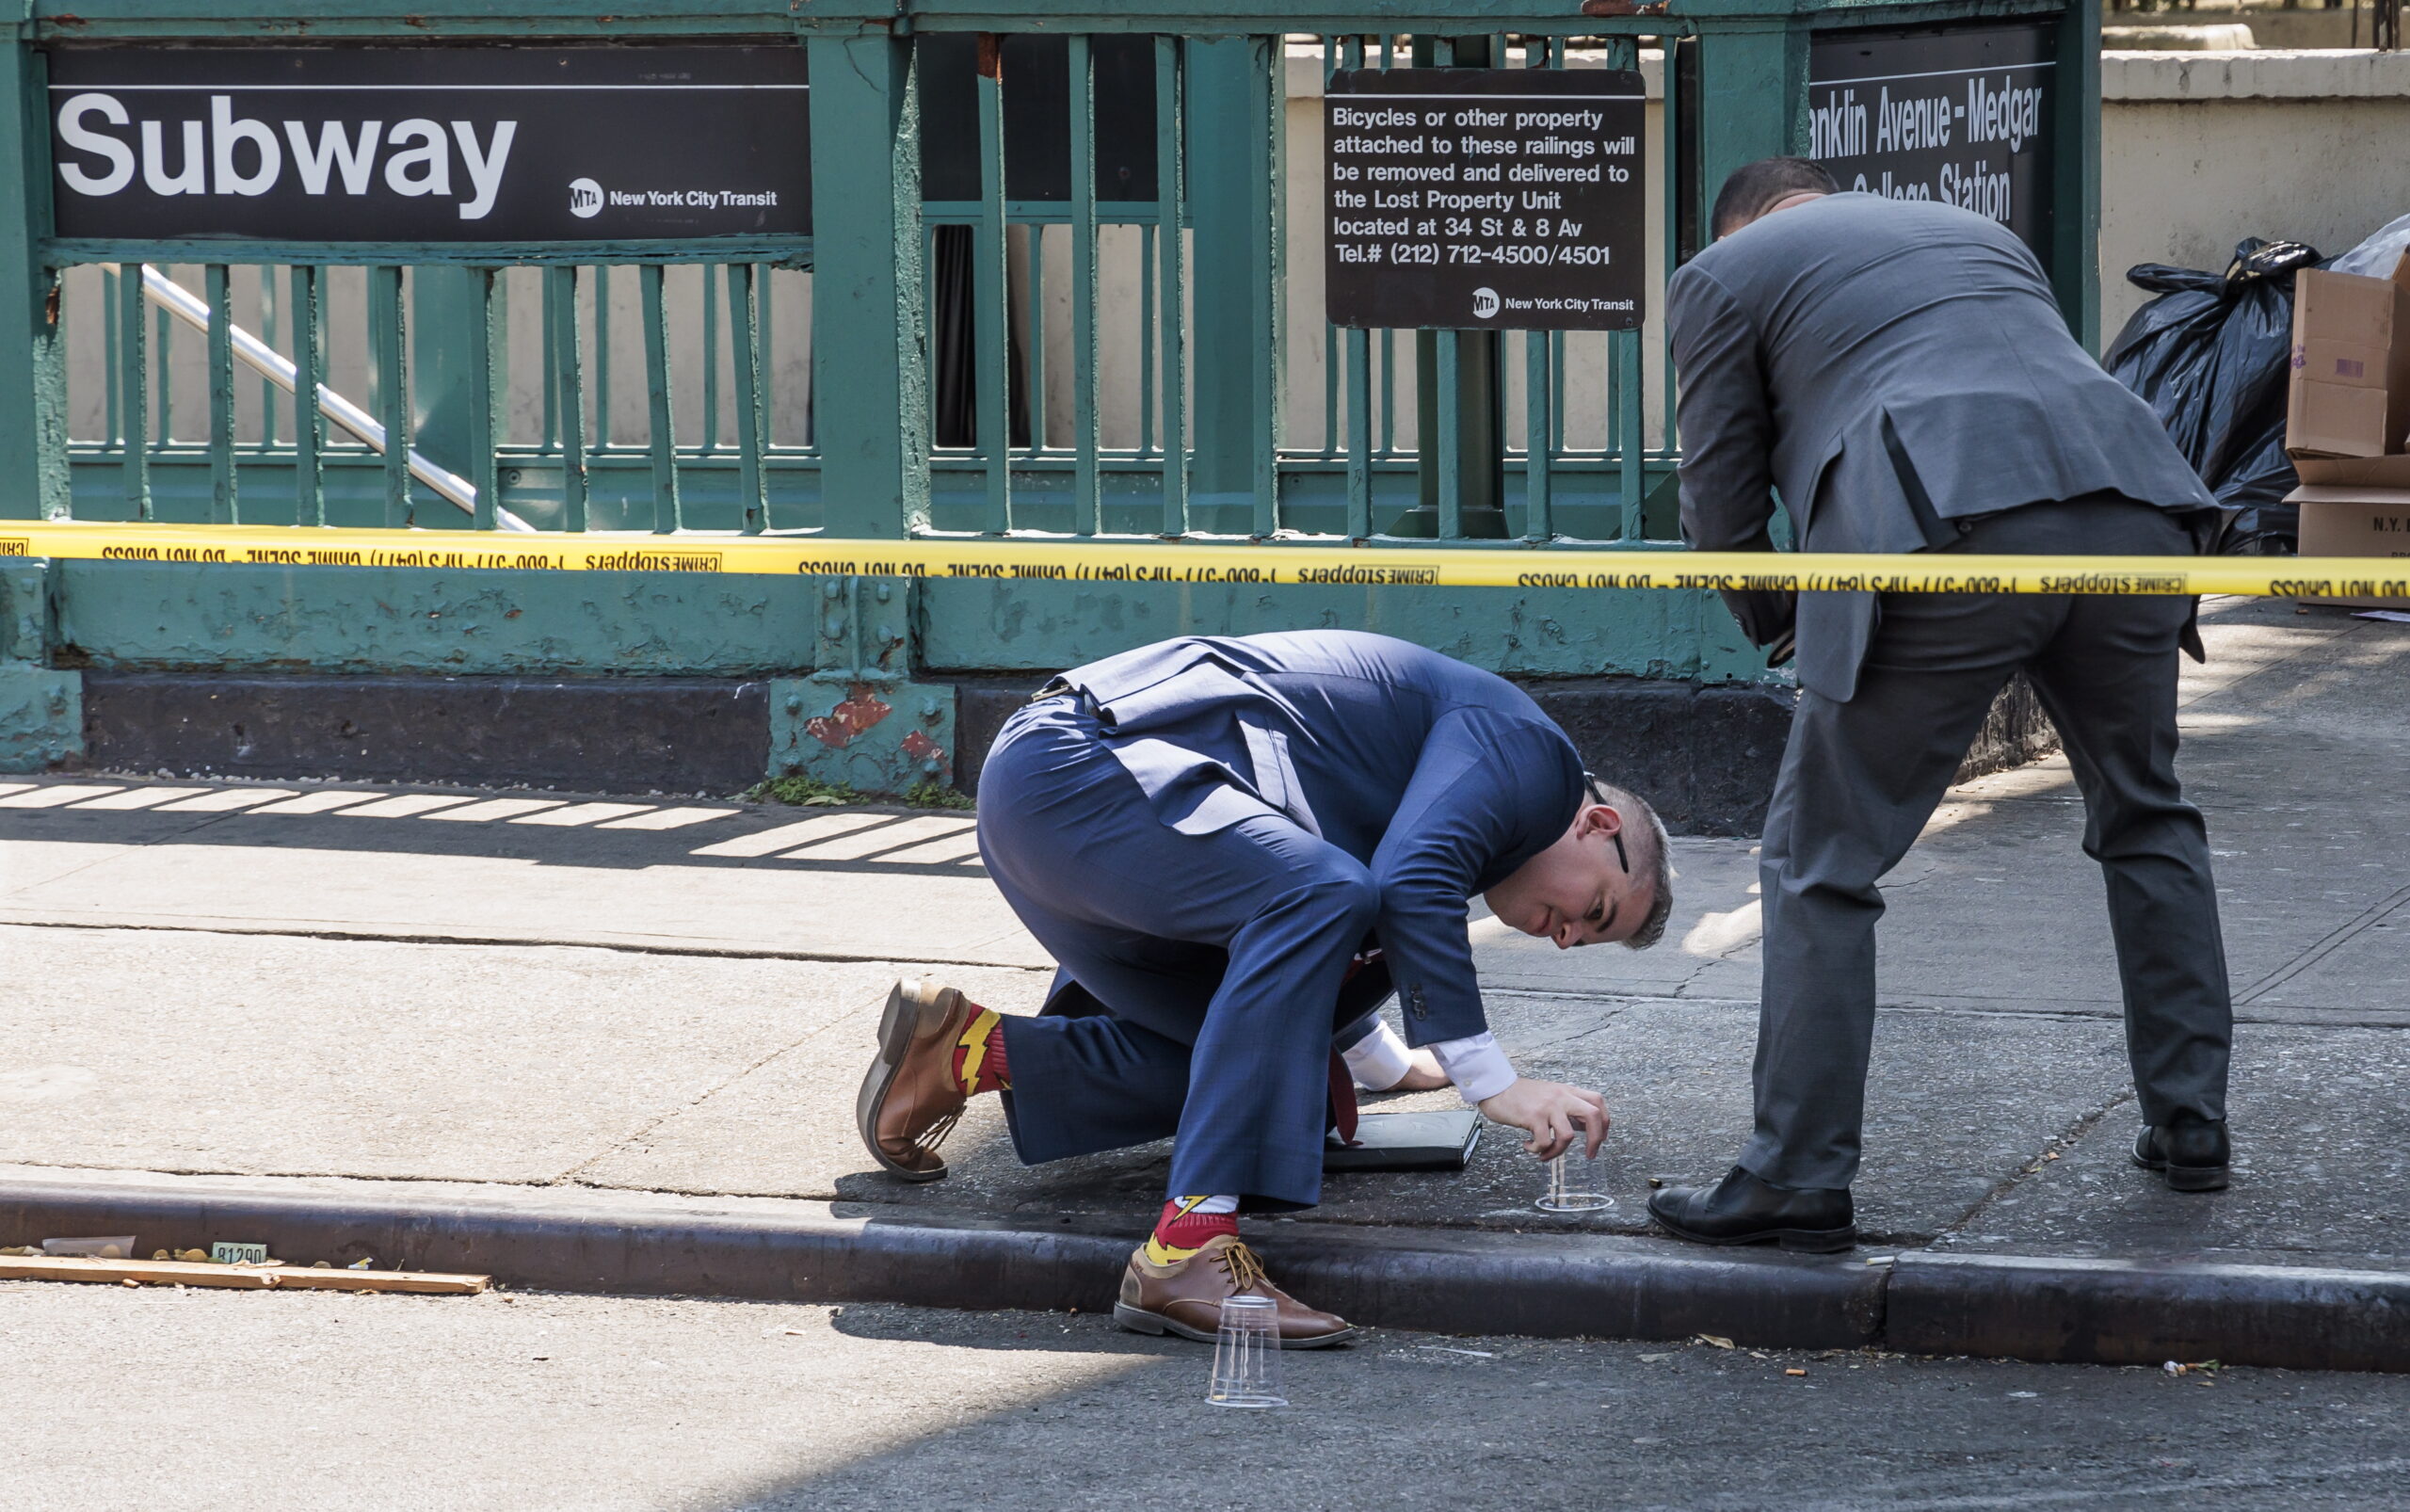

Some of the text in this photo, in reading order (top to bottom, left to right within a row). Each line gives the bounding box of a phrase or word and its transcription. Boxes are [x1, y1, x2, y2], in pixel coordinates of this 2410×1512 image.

[1333, 107, 1603, 131] Bicycles or other property
[1808, 88, 1867, 160] anklin
[58, 93, 517, 219] Subway
[1333, 135, 1635, 159] attached to these railings will
[1333, 163, 1630, 183] be removed and delivered to
[609, 190, 778, 210] New York City Transit
[1333, 189, 1562, 213] the Lost Property Unit
[1940, 160, 2010, 221] Station
[1334, 217, 1583, 237] located at 34 St & 8 Av
[1334, 242, 1611, 266] Tel.# (212) 712-4500/4501
[1505, 298, 1634, 313] New York City Transit
[2373, 517, 2402, 532] N.Y.
